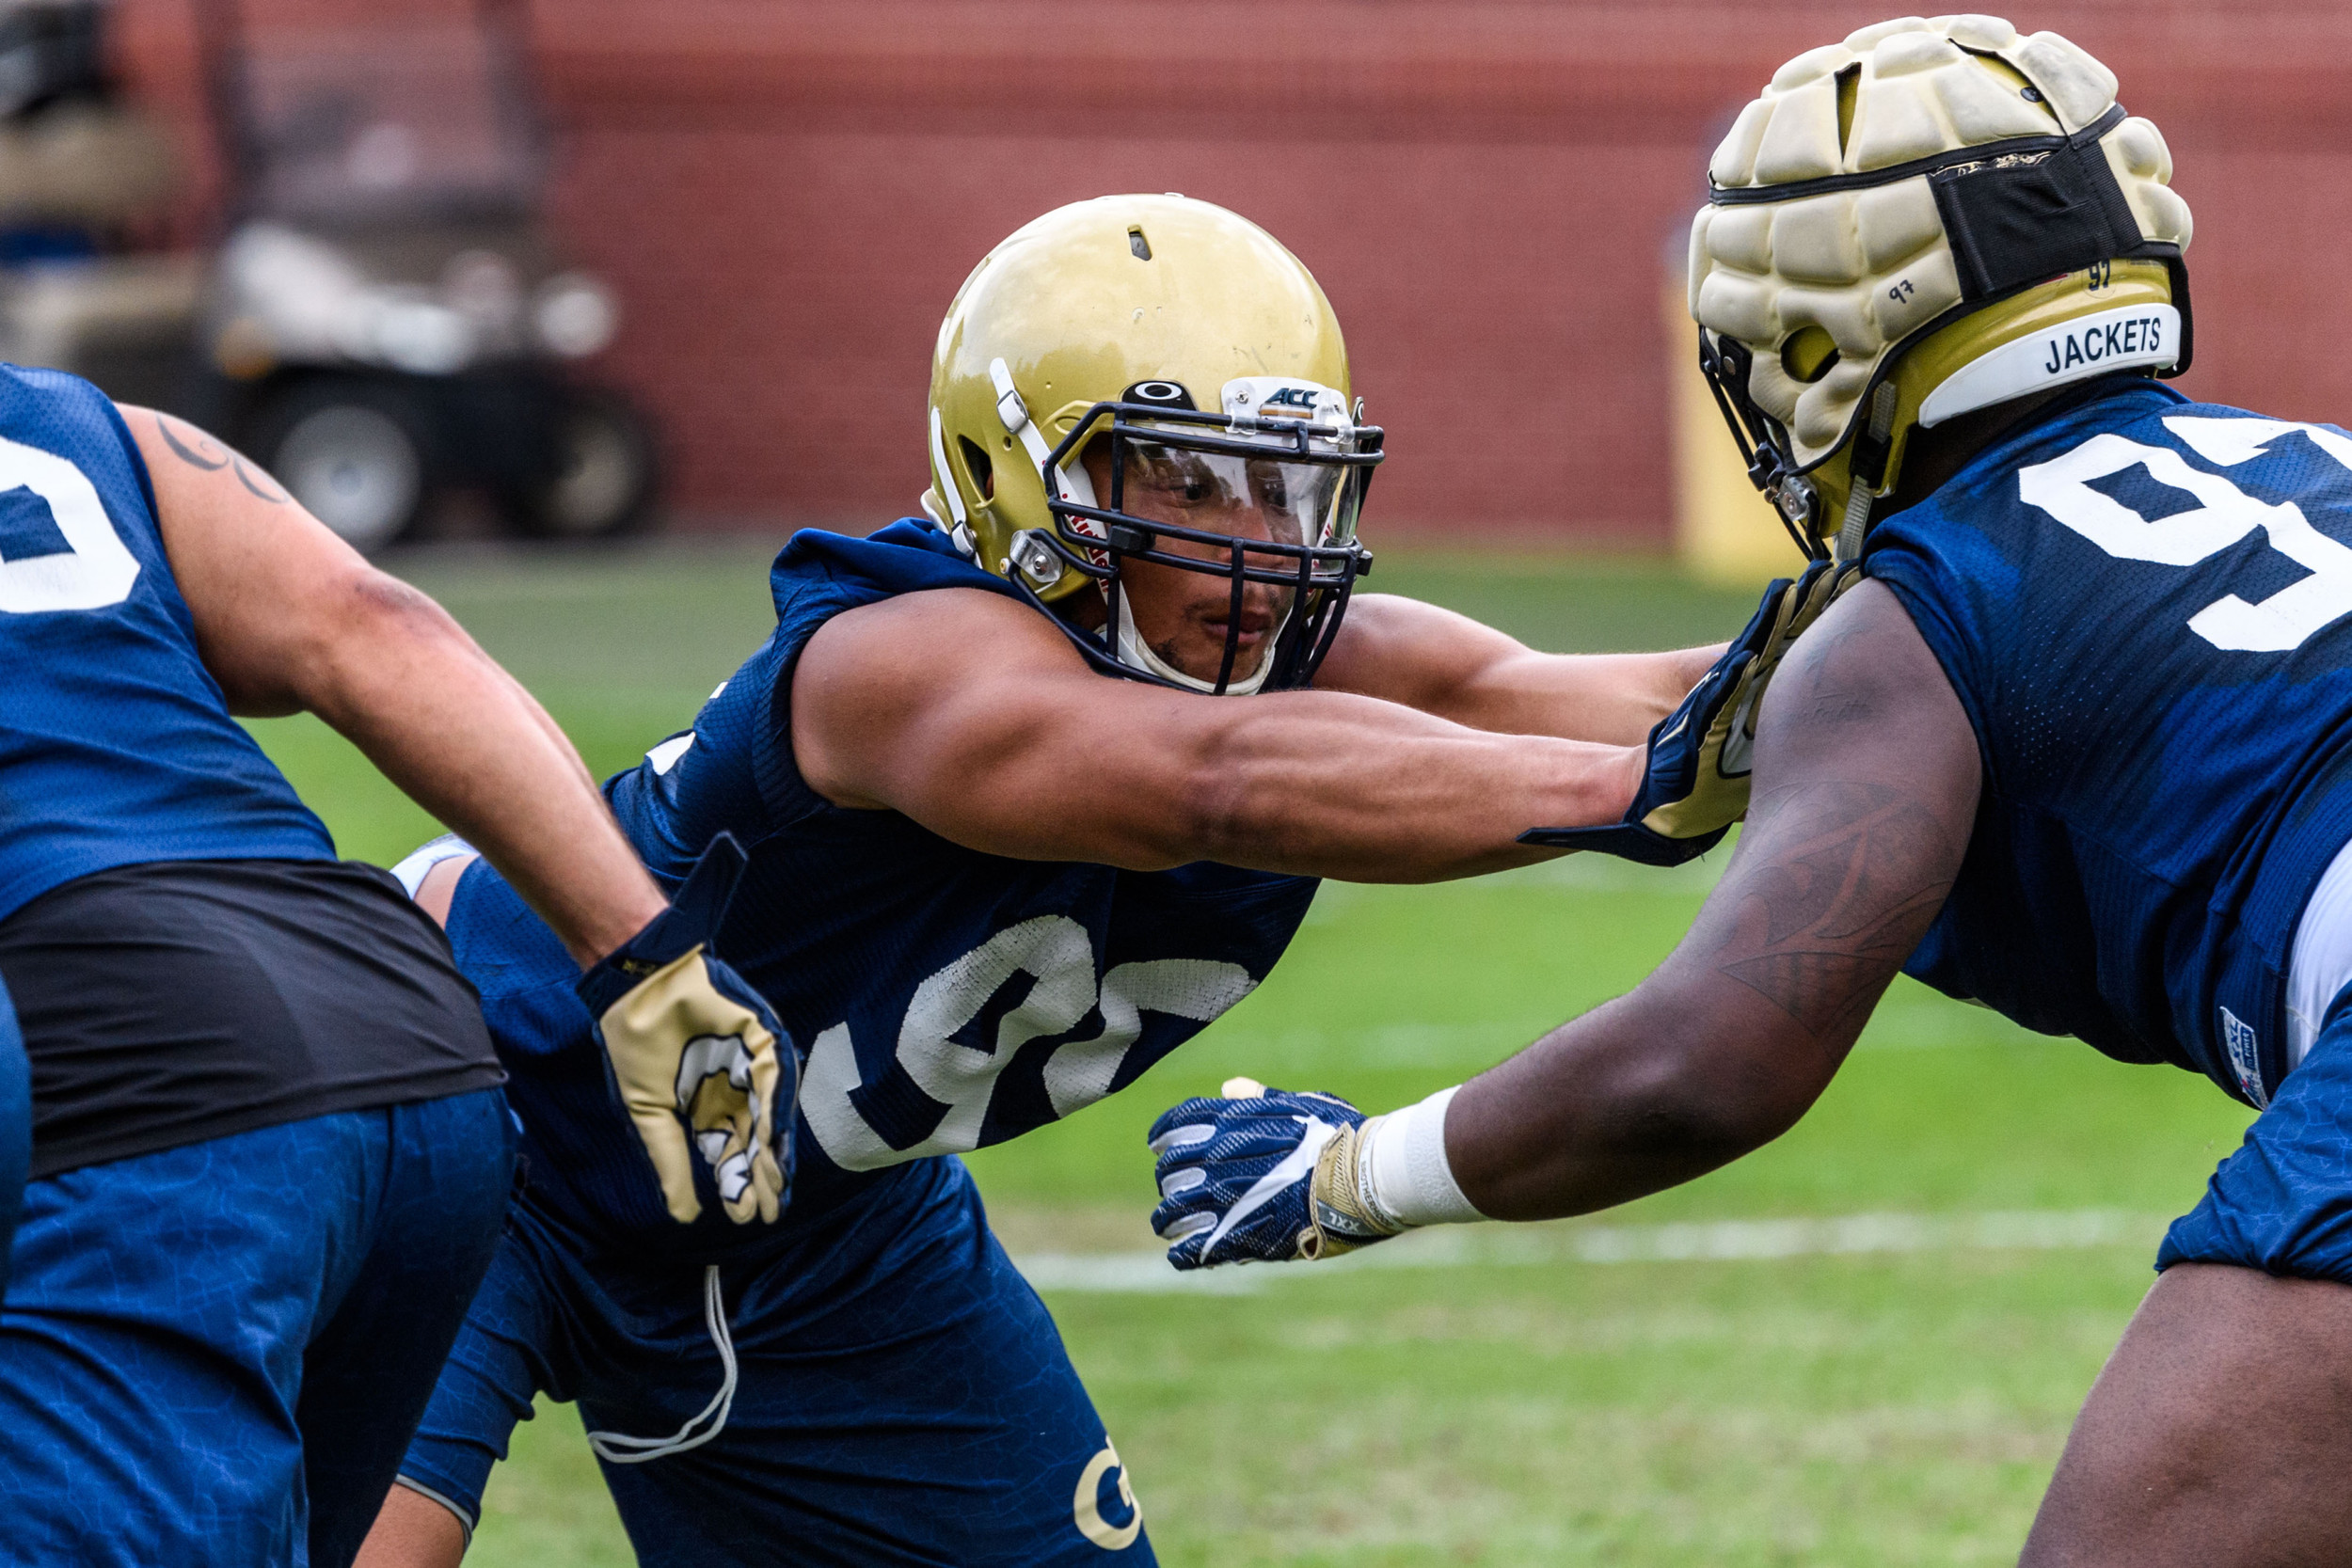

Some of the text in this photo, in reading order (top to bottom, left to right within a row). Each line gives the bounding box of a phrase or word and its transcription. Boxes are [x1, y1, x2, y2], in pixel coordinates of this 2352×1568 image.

[1889, 278, 1915, 304] 97
[2044, 317, 2162, 373] JACKETS
[1264, 388, 1319, 408] ACC
[1328, 1212, 1359, 1232] XXL
